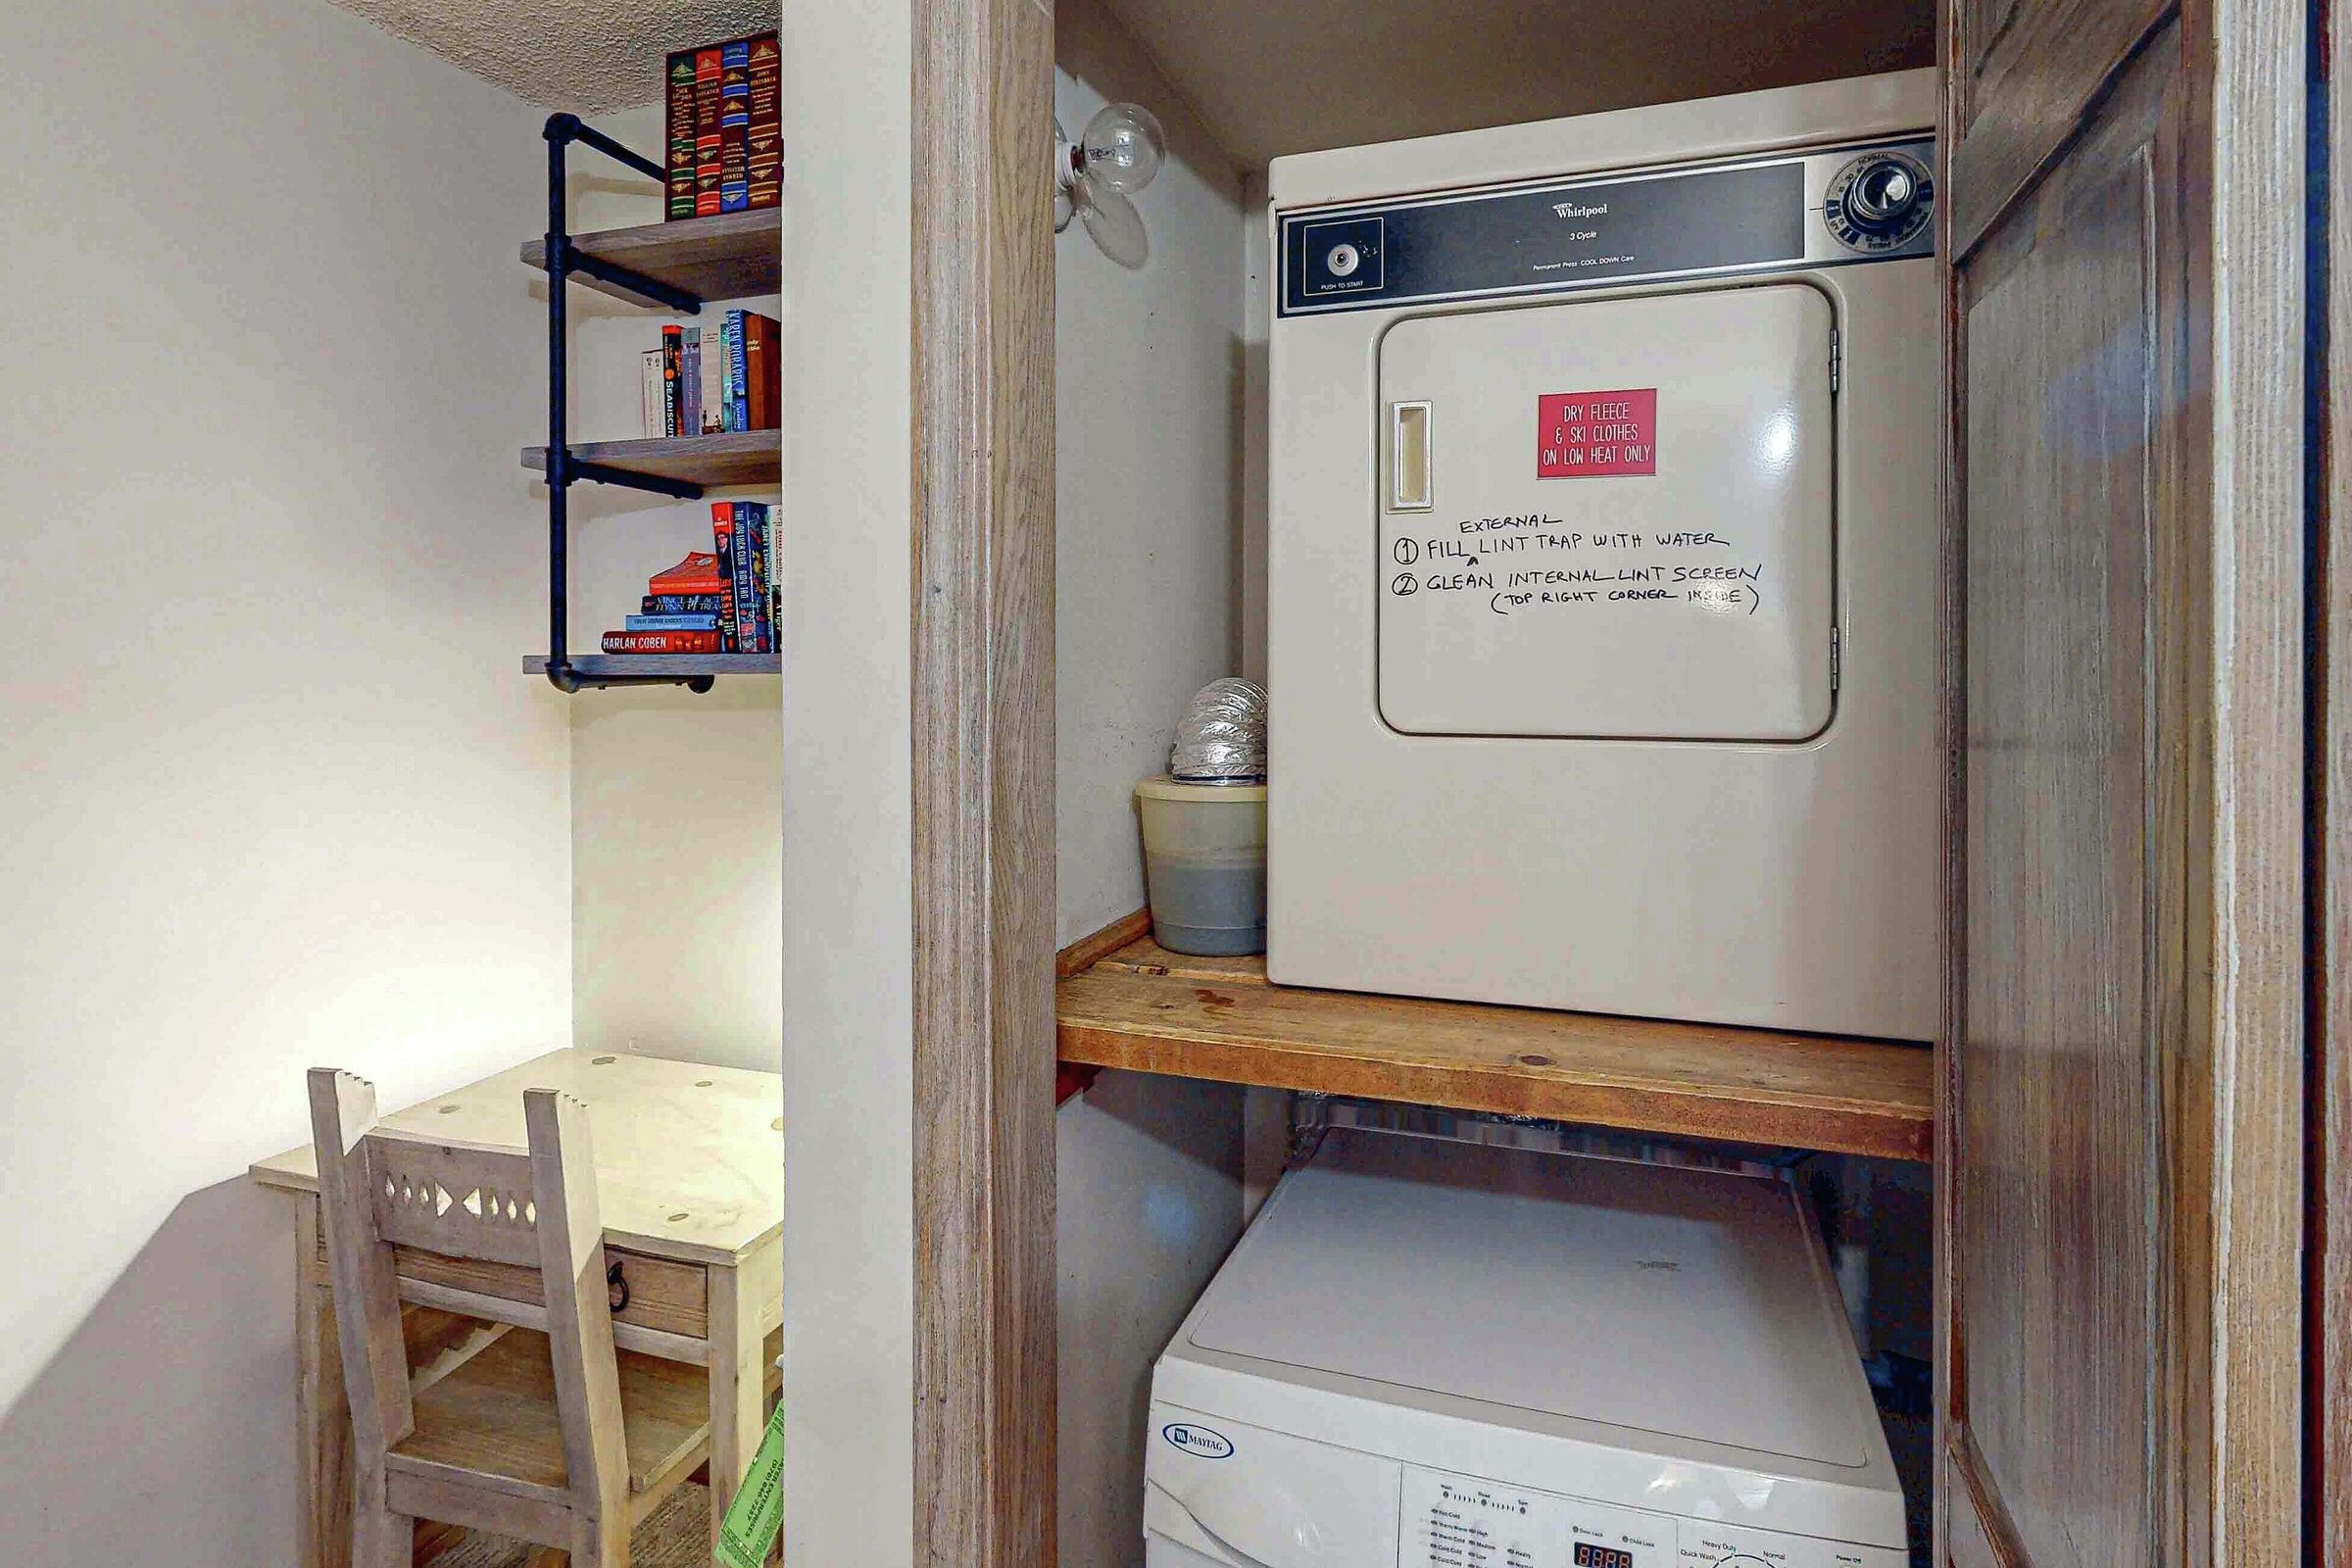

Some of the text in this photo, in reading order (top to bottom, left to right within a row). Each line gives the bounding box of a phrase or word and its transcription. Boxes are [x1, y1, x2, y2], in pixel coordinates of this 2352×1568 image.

[1557, 203, 1608, 218] Whirlpool
[1576, 231, 1597, 241] Cycle
[727, 313, 741, 342] KAREN
[1564, 402, 1631, 422] DRY FLEECE
[1555, 423, 1638, 444] & SKI CLOTHES
[1543, 444, 1650, 466] ON LOW HEAT ONLY
[735, 511, 744, 520] THE
[735, 522, 744, 534] JOY
[1459, 515, 1563, 534] EXTERNAL
[736, 535, 745, 551] LUCK
[1427, 539, 1471, 560] FILL
[1480, 536, 1528, 554] LINT
[1536, 533, 1582, 551] TRAP
[1592, 533, 1642, 549] WITH
[1656, 532, 1730, 548] WATER
[738, 570, 747, 585] AMY
[1426, 572, 1494, 590] CLEAN
[1507, 567, 1616, 586] INTERNAL
[1618, 566, 1665, 582] LINT
[1672, 564, 1762, 581] SCREEN
[740, 587, 749, 599] TAN
[1491, 592, 1534, 614] (TOP
[1541, 590, 1599, 606] RIGHT
[1608, 588, 1679, 603] CORNER
[603, 637, 636, 649] HARLAN
[639, 636, 666, 649] COBEN
[1189, 1435, 1223, 1450] MAYTAG
[745, 1484, 774, 1538] ENTERPRISES
[1702, 1539, 1737, 1552] Heavy Duty
[1680, 1548, 1717, 1561] Quick Wash
[1763, 1550, 1786, 1560] Normal
